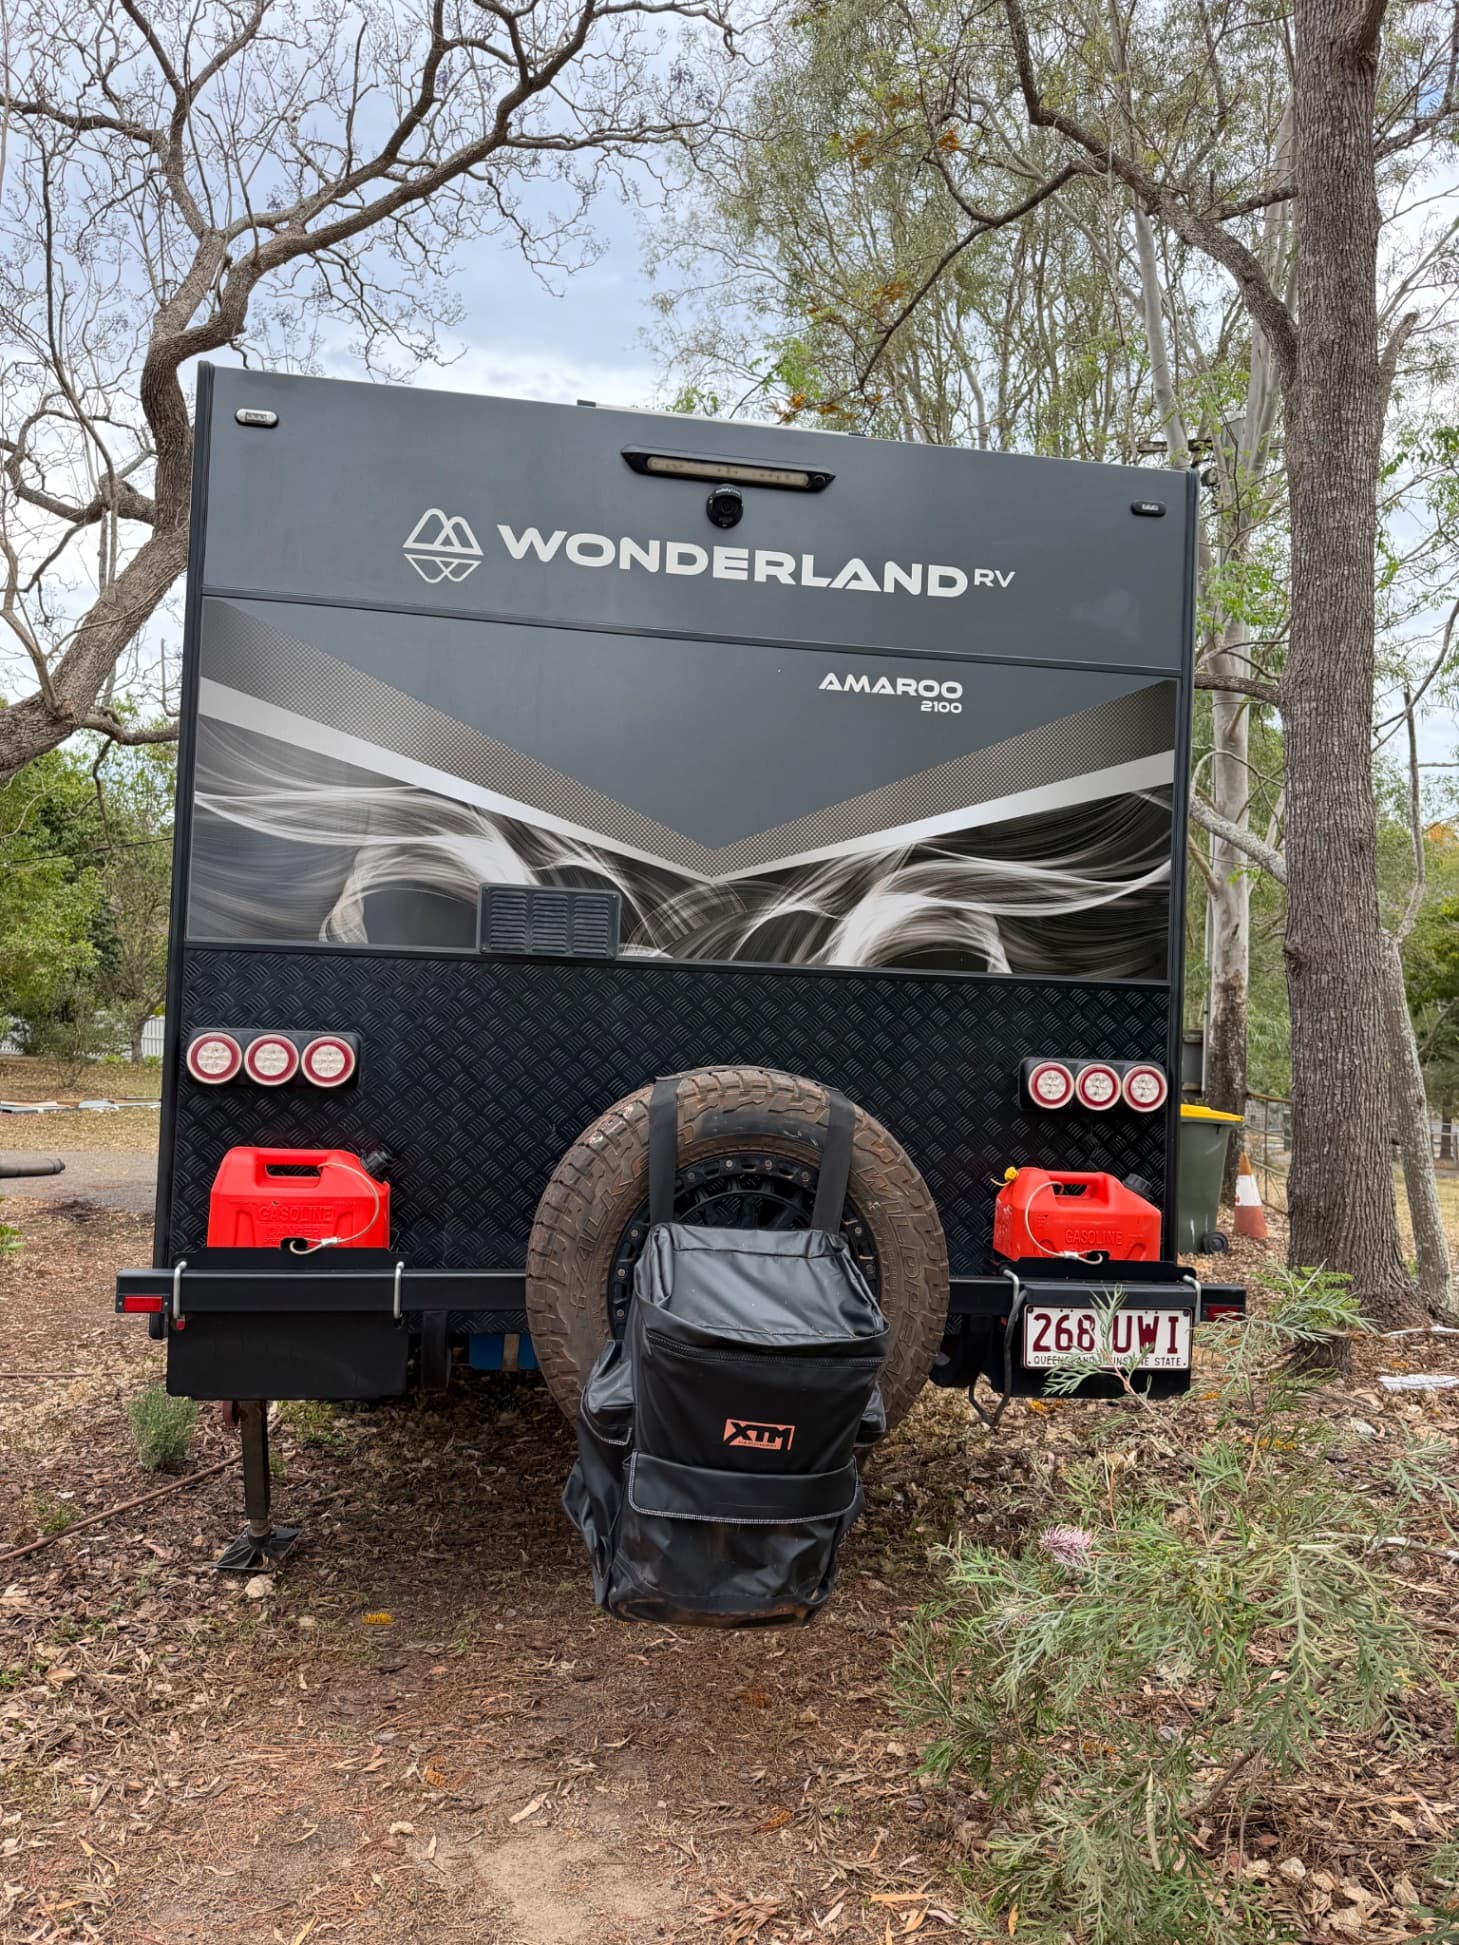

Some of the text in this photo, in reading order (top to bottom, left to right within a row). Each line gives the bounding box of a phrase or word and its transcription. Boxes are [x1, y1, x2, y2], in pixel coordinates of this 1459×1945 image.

[496, 523, 1016, 598] WONDERLAND RV
[818, 672, 963, 699] AMAROO
[920, 700, 963, 713] 2100
[259, 1205, 334, 1222] GASOLINE
[1065, 1229, 1123, 1246] GASOLINE
[1033, 1313, 1179, 1354] 268 UWI
[1154, 1357, 1181, 1366] STATE
[725, 1421, 792, 1450] XTM
